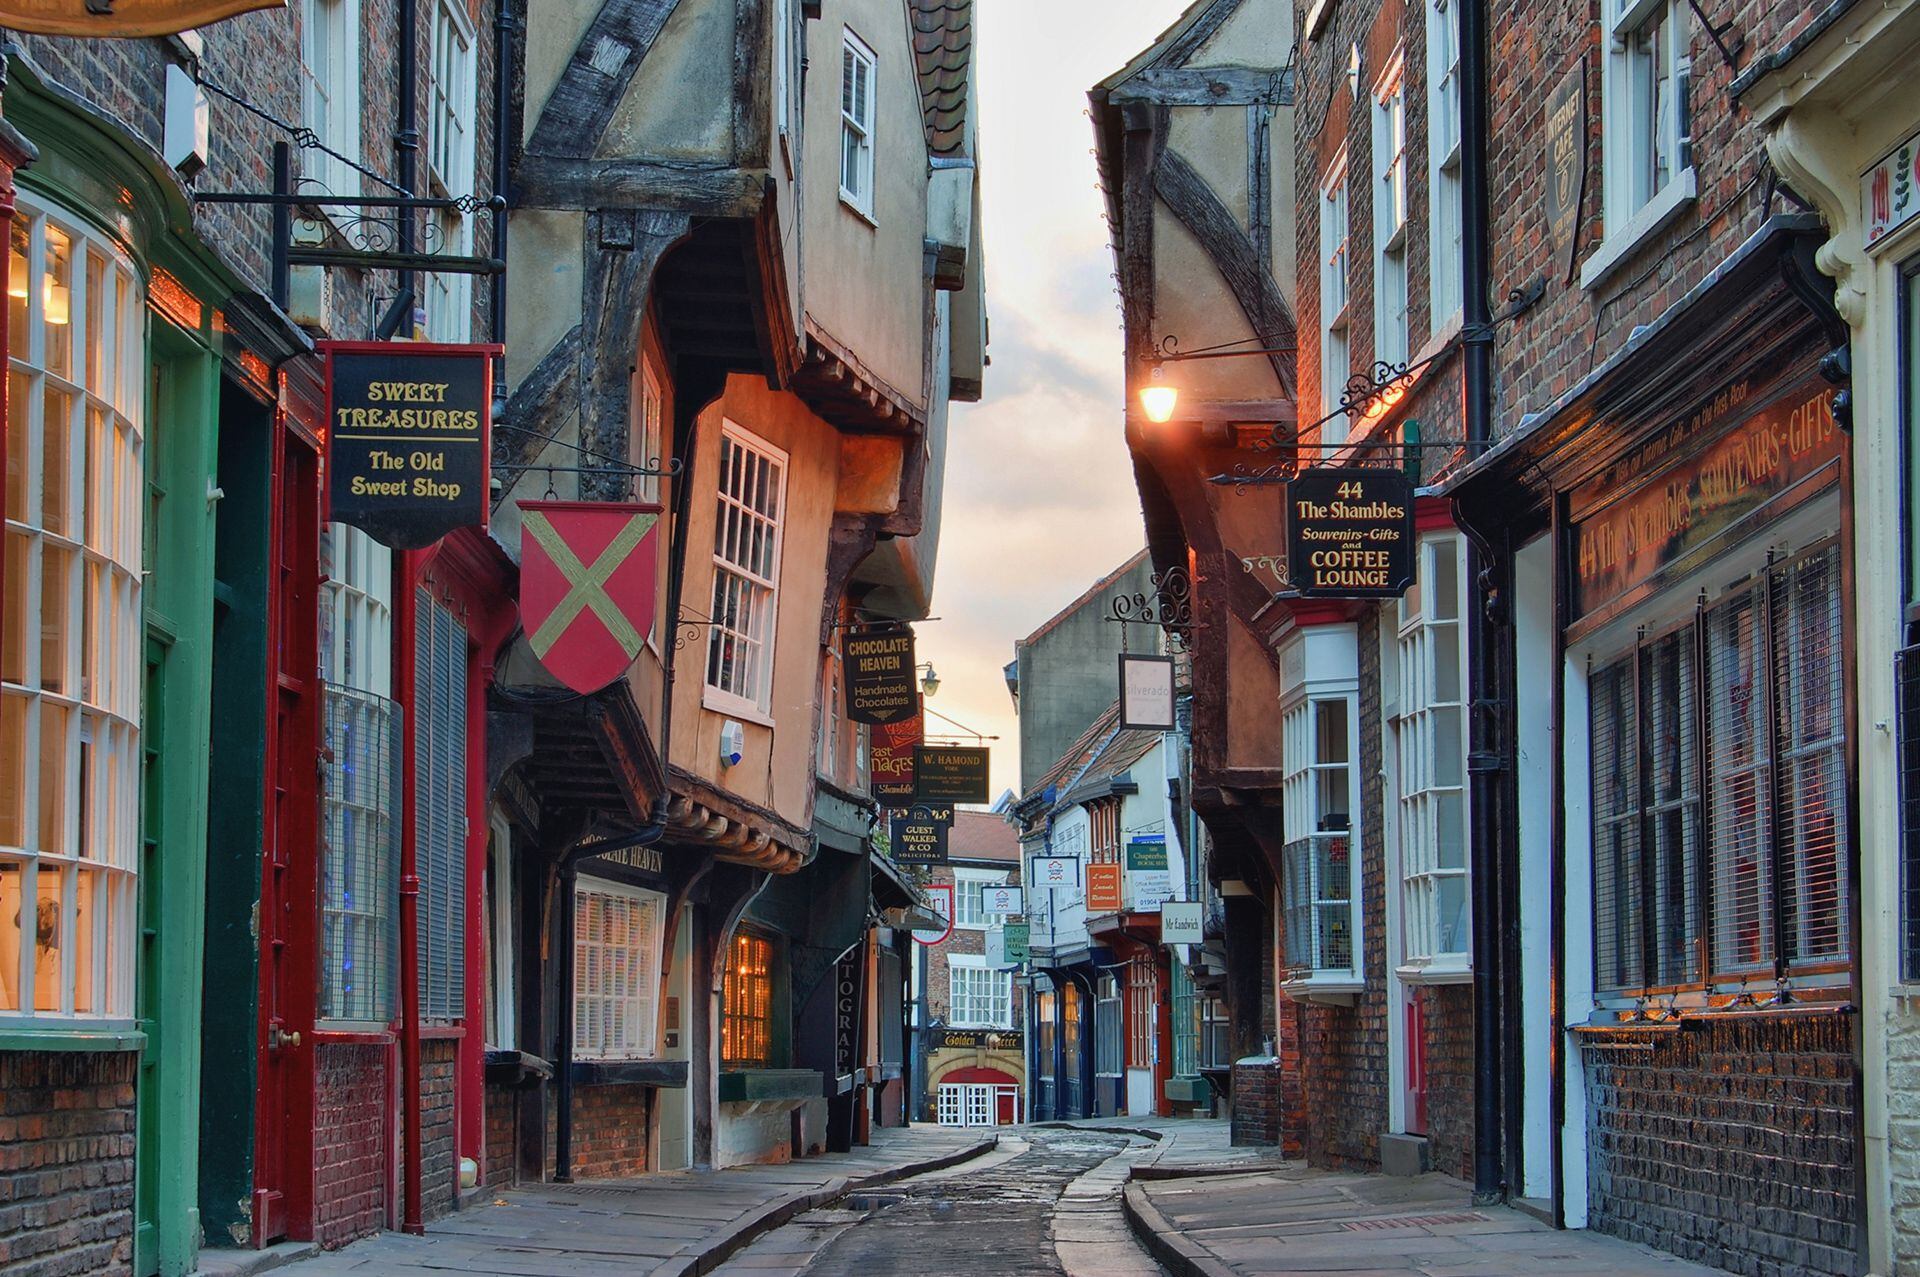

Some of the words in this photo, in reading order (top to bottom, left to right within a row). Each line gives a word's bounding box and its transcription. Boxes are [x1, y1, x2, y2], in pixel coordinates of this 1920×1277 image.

[1547, 88, 1580, 143] INTERNET
[367, 381, 450, 402] SWEET
[337, 407, 479, 431] TREASURES
[368, 450, 404, 470] The
[409, 451, 445, 471] Old
[351, 475, 408, 497] Sweet
[412, 477, 461, 501] Shop
[1337, 481, 1364, 499] 44
[1580, 529, 1596, 578] 44
[1700, 422, 1781, 509] SOUVENIRS
[1789, 388, 1834, 456] GIFTS
[1297, 501, 1328, 518] The
[1330, 501, 1405, 519] Shambles
[1341, 541, 1362, 549] and
[1311, 550, 1390, 568] COFFEE
[1315, 570, 1389, 586] LOUNGE
[848, 638, 910, 656] CHOCOLATE
[859, 656, 901, 672] HEAVEN
[854, 683, 908, 697] Handmade
[854, 695, 910, 709] Chocolates
[938, 755, 981, 766] HAMOND
[902, 835, 938, 843] WALKER
[905, 826, 935, 835] GUEST
[908, 844, 916, 852] &
[917, 844, 932, 852] CO
[630, 846, 662, 873] HEAVEN
[944, 1035, 976, 1046] Golden
